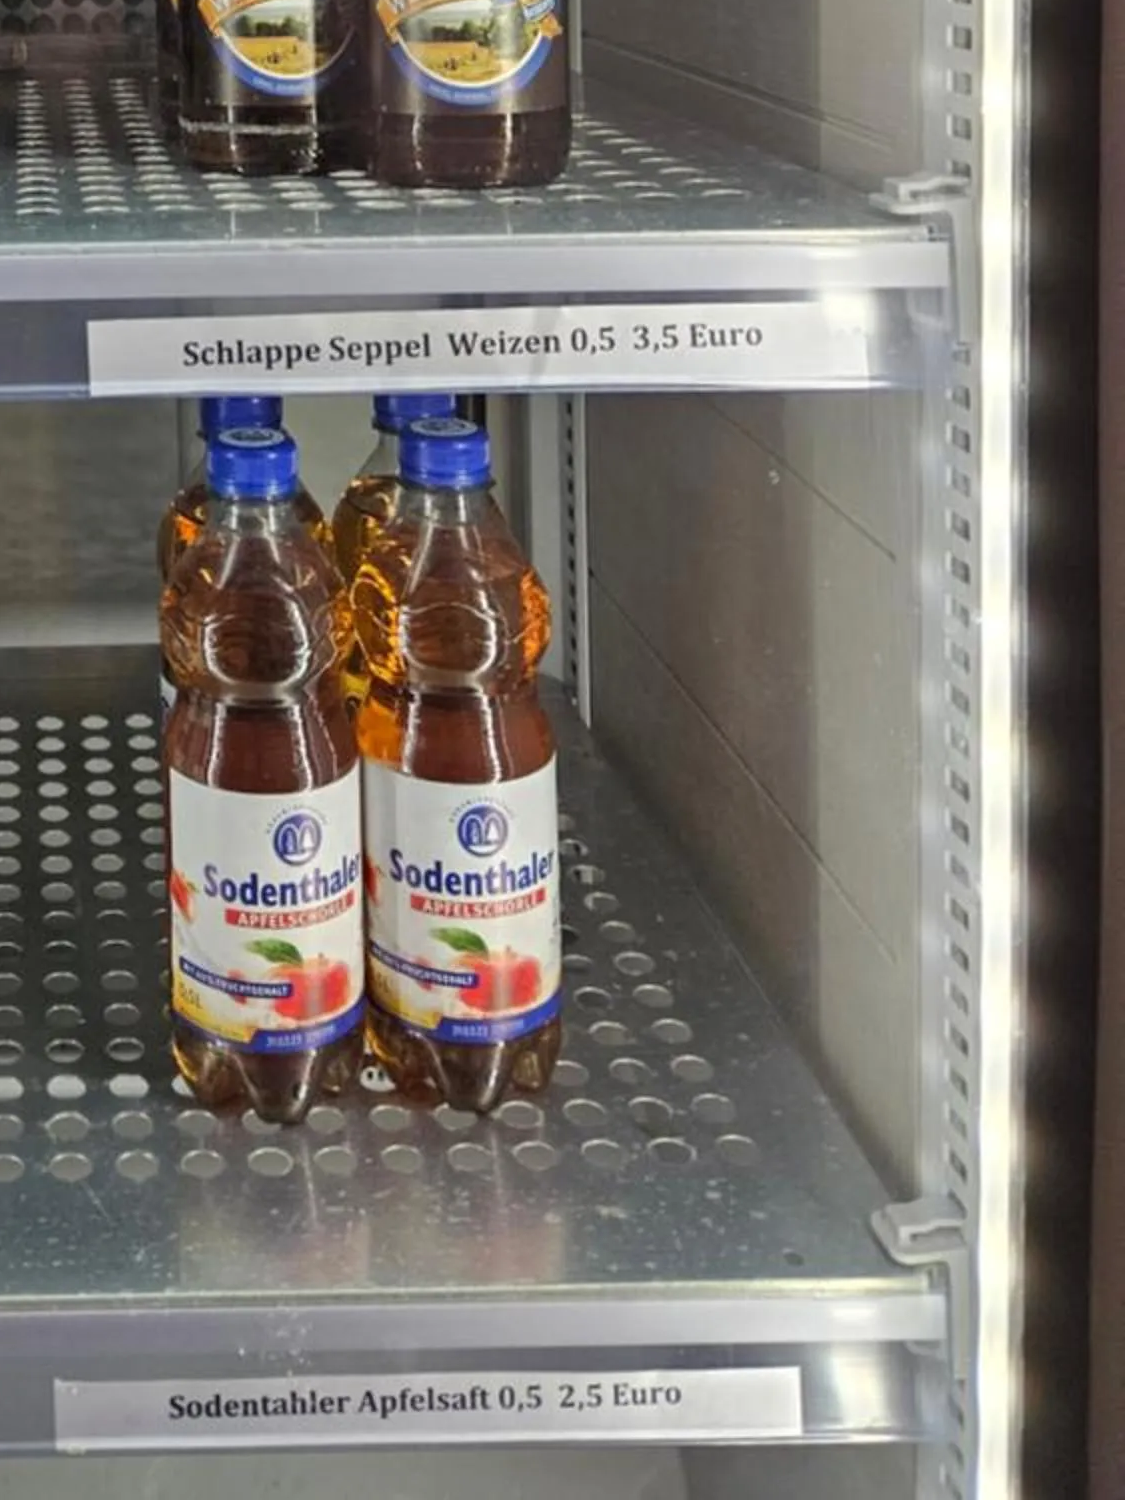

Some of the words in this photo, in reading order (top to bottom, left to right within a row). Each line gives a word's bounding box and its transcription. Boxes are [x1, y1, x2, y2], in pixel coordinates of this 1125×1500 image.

[182, 338, 321, 370] Schlappe
[329, 333, 431, 366] Seppel
[447, 329, 561, 357] Weizen
[571, 326, 616, 355] 0,5
[633, 324, 679, 353] 3,5
[690, 322, 762, 348] Euro
[389, 848, 555, 896] Sodenthaler
[422, 892, 536, 918] APFELSCHORLE
[168, 1389, 351, 1420] Sodentahler
[358, 1385, 490, 1419] Apfelsaft
[499, 1384, 542, 1412] 0,5
[559, 1383, 603, 1411] 2,5
[613, 1381, 682, 1407] Euro
